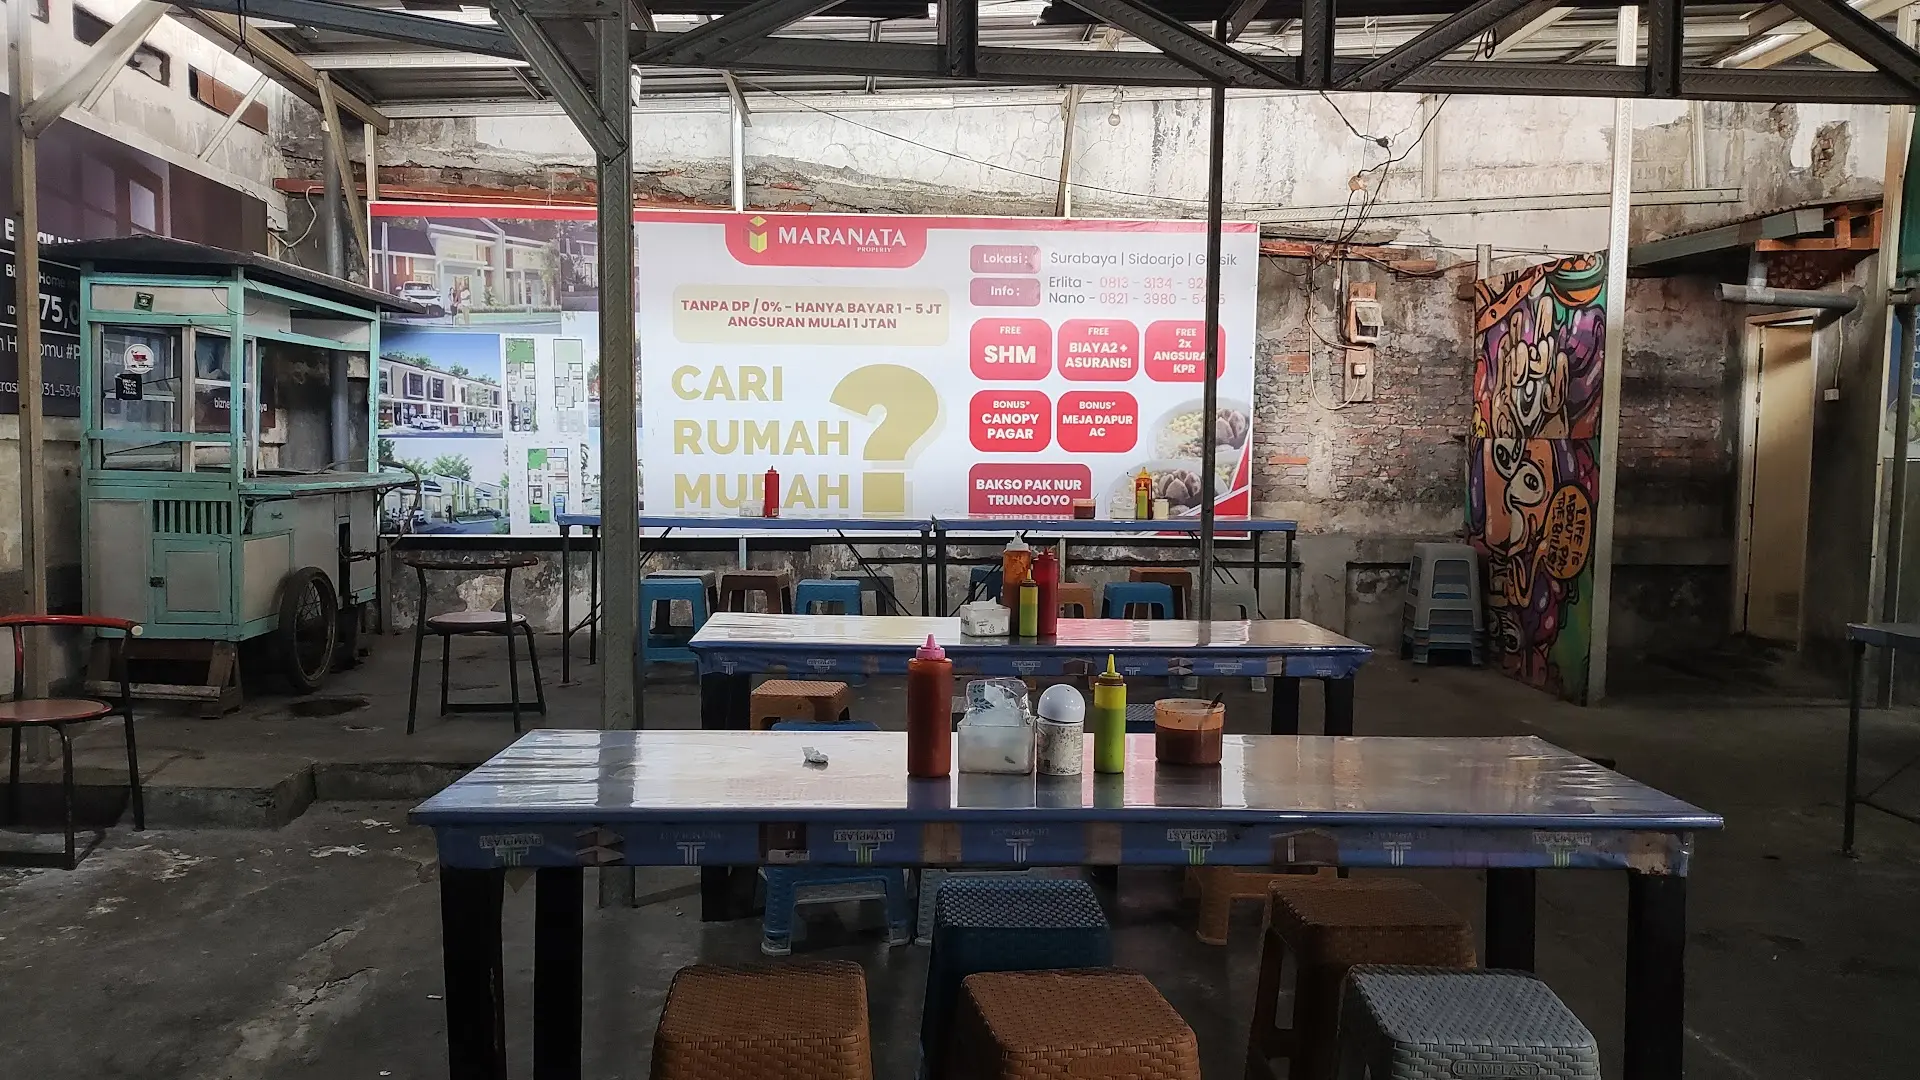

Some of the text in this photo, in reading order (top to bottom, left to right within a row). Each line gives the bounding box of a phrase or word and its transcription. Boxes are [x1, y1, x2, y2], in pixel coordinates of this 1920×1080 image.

[778, 226, 907, 246] MARANATA
[1050, 252, 1117, 267] Surabaya
[1128, 252, 1184, 268] Sidoarjo
[1195, 253, 1237, 266] Gsik
[1049, 276, 1082, 288] Erlita
[1100, 277, 1129, 289] 0813
[1143, 277, 1173, 289] 3134
[1188, 278, 1207, 290] 92
[990, 285, 1014, 296] Info
[1049, 292, 1085, 304] Nano
[1100, 293, 1128, 304] 0821
[1143, 293, 1177, 305] 3980
[1192, 294, 1226, 305] 545
[681, 300, 729, 312] TANPA
[732, 301, 750, 312] DP
[761, 301, 782, 312] 0%
[795, 302, 845, 313] HANYA
[847, 303, 894, 314] BAYAR
[926, 304, 942, 314] JT
[728, 316, 805, 328] ANGSURAN
[808, 318, 850, 328] MULAI
[861, 318, 897, 329] JTAN
[1000, 326, 1021, 335] FREE
[1088, 327, 1109, 336] FREE
[1175, 328, 1197, 336] FREE
[1069, 342, 1117, 353] BIAYA2
[1178, 339, 1192, 348] 2x
[984, 345, 1036, 364] SHM
[1153, 351, 1206, 361] ANGSURA
[1065, 357, 1132, 369] ASURANSI
[1173, 364, 1196, 374] KPR
[671, 364, 783, 401] CARI
[982, 413, 1039, 425] CANOPY
[1062, 415, 1133, 425] MEJA DAPUR
[673, 419, 849, 456] RUMAH
[987, 428, 1034, 439] PAGAR
[1089, 427, 1106, 437] AC
[976, 479, 1082, 490] BAKSO PAK NUR
[987, 494, 1070, 505] TRUNOJOYO
[1554, 491, 1566, 520] THE
[1573, 506, 1587, 547] LIFE
[1556, 493, 1577, 577] ABOUT PAY
[834, 830, 894, 841] OLYMPLAST
[1167, 829, 1227, 840] OLYMPLAST
[1457, 1062, 1537, 1076] OLYMPLAST
